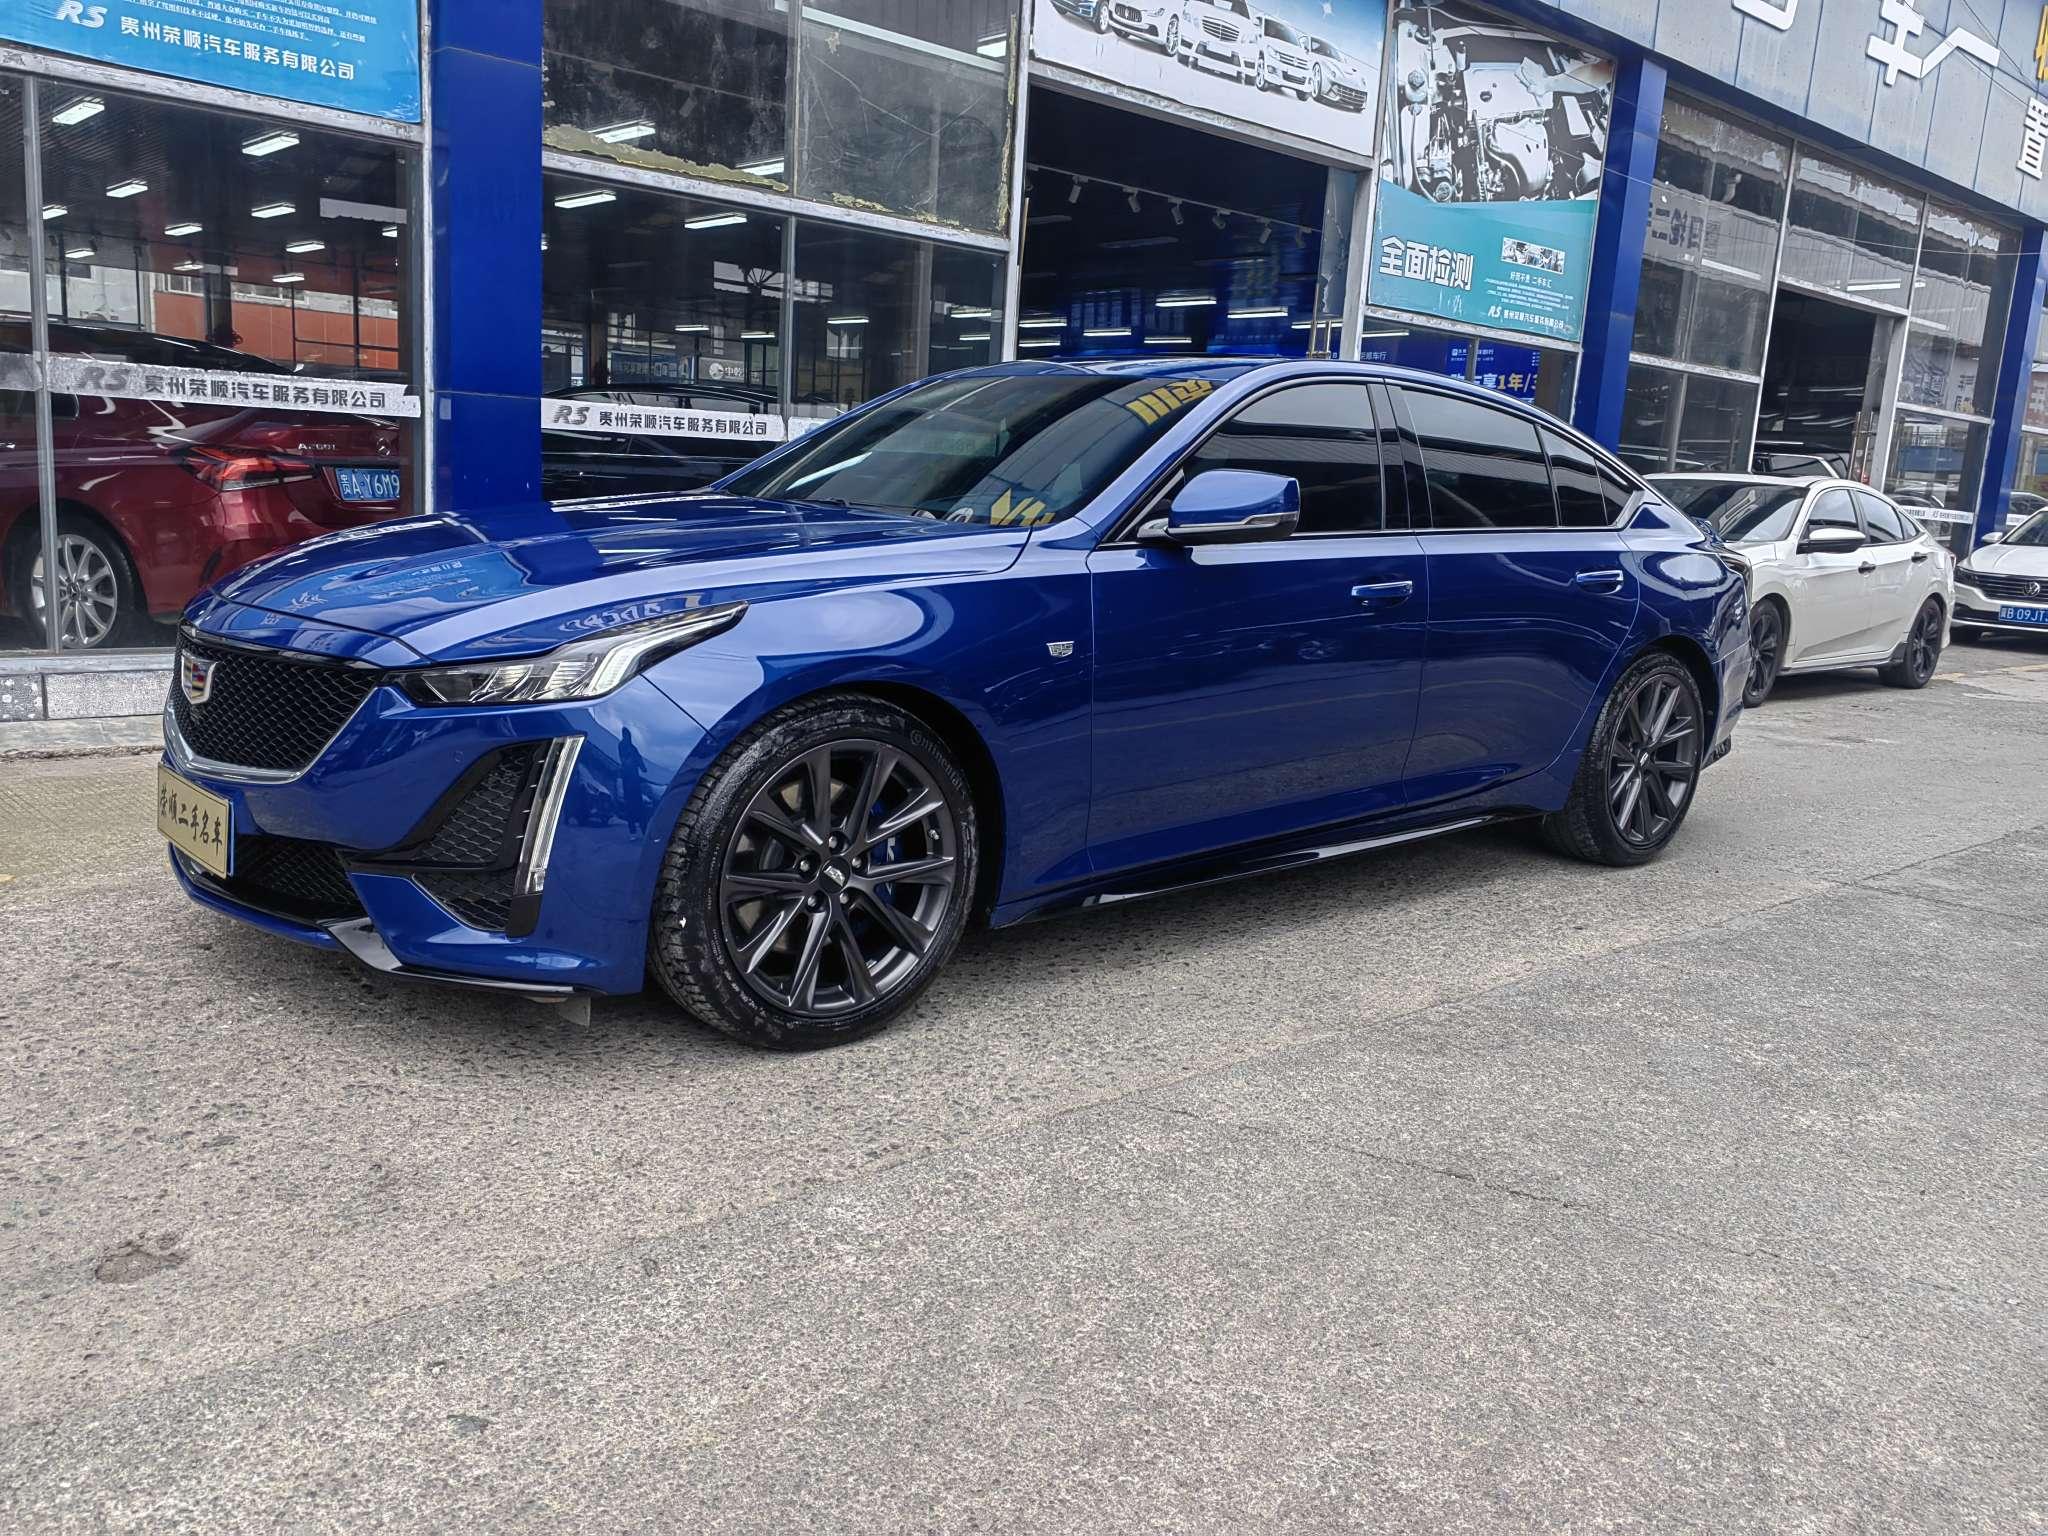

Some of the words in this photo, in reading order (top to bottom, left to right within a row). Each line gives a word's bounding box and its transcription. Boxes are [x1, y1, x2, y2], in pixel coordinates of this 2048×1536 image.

[55, 0, 108, 28] RS
[120, 16, 354, 80] 贵州荣顺汽车服务有限公司
[1379, 235, 1474, 291] 全面检测
[145, 375, 386, 408] 贵州荣顺汽车服务有限公司
[553, 405, 590, 425] RS
[599, 411, 767, 436] 贵州荣顺汽车服务有限公司
